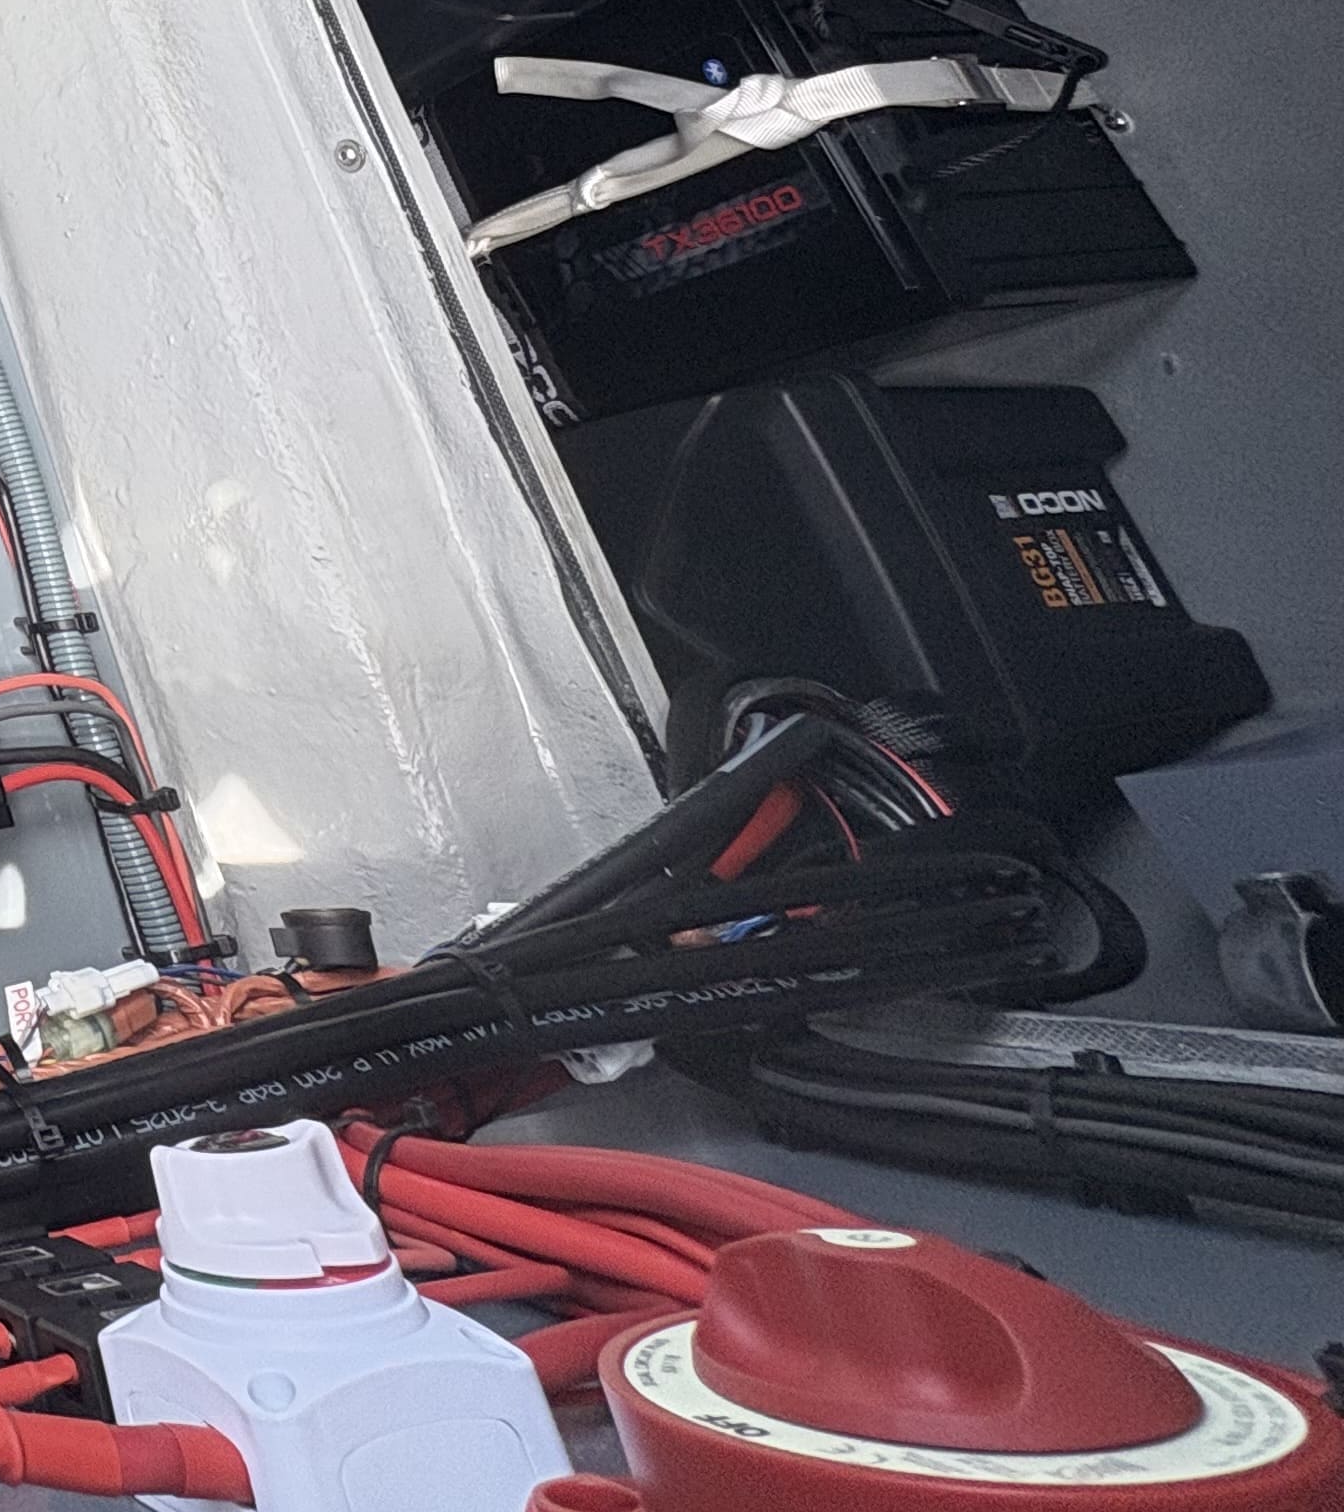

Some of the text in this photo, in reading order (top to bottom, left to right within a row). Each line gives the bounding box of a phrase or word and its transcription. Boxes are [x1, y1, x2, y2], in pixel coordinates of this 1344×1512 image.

[644, 185, 803, 261] TX36100
[1016, 489, 1107, 516] NOCO
[1013, 535, 1070, 607] BG31
[693, 1413, 770, 1439] OFF
